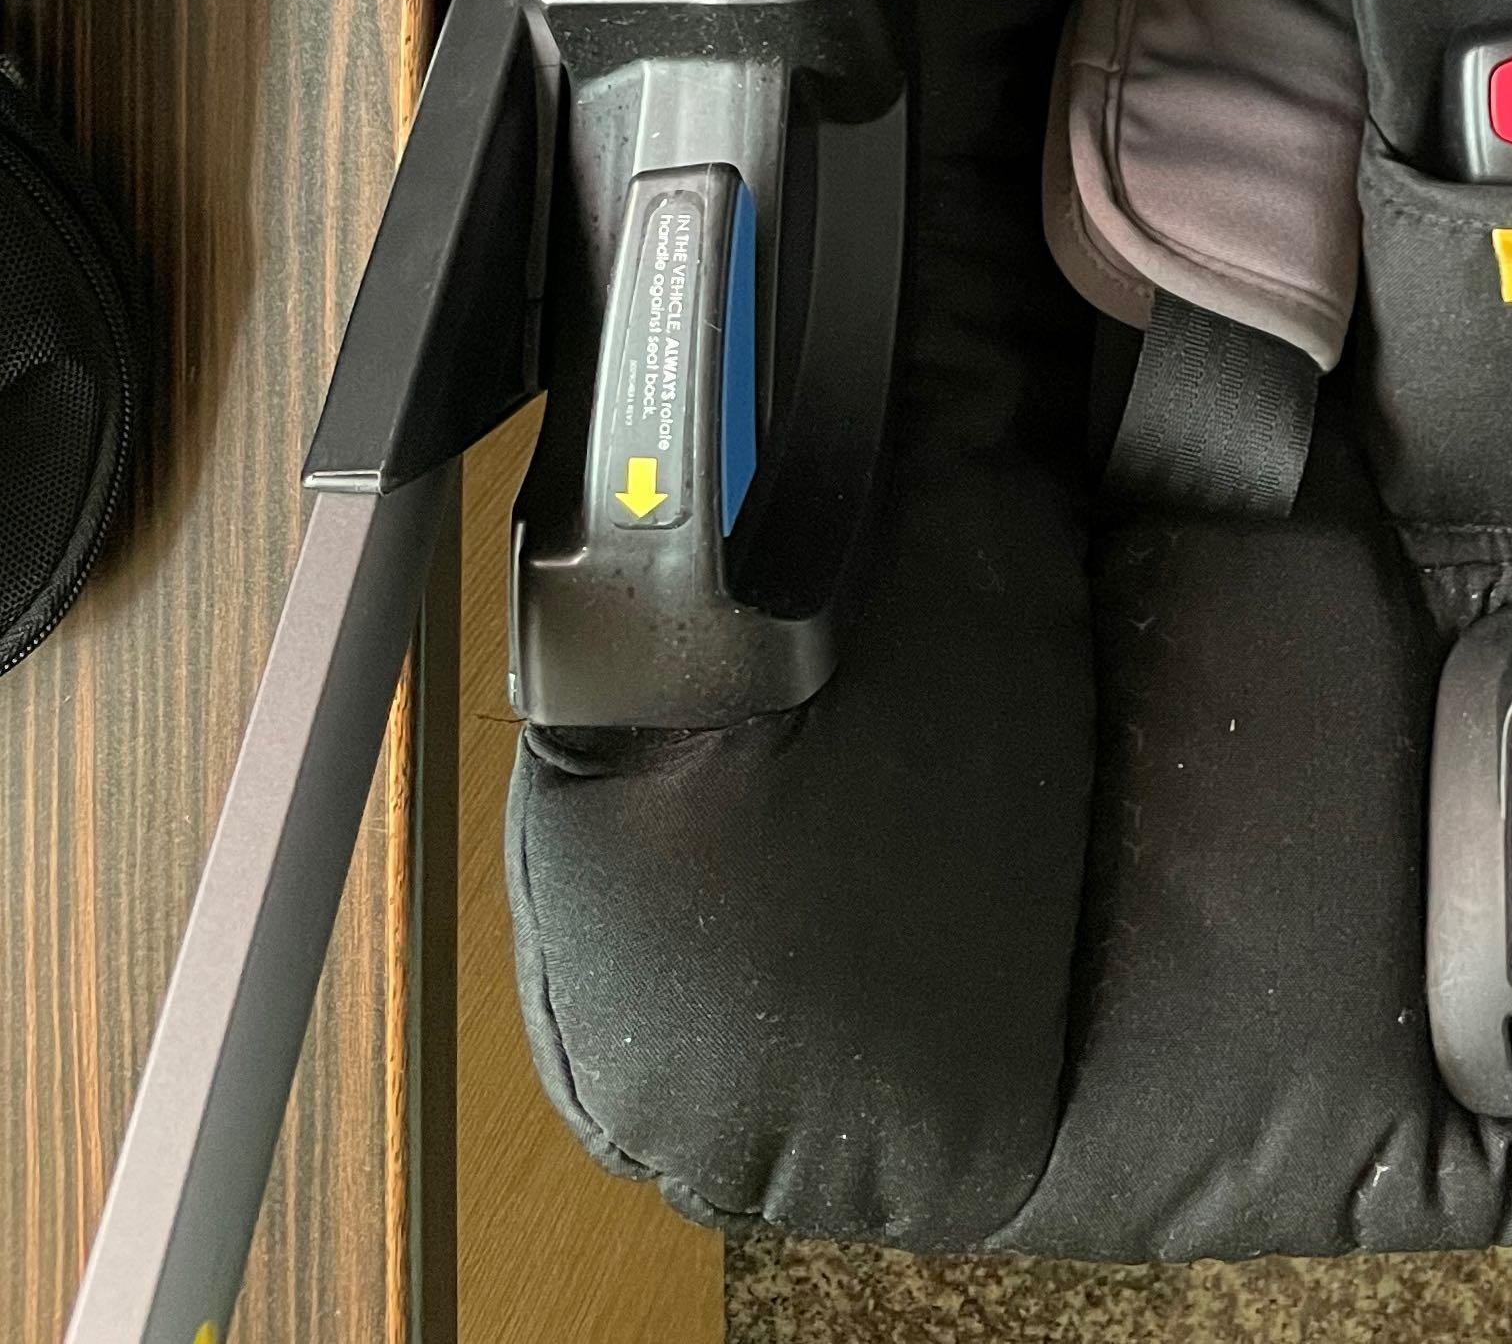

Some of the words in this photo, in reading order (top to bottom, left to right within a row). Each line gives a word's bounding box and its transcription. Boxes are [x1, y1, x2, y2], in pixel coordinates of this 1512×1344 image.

[655, 215, 674, 270] handle
[676, 215, 690, 233] IN
[673, 234, 689, 261] THE
[649, 273, 664, 333] against
[646, 336, 660, 370] seat
[661, 337, 679, 400] ALWAYS
[643, 374, 658, 419] back.
[658, 403, 674, 450] rotate
